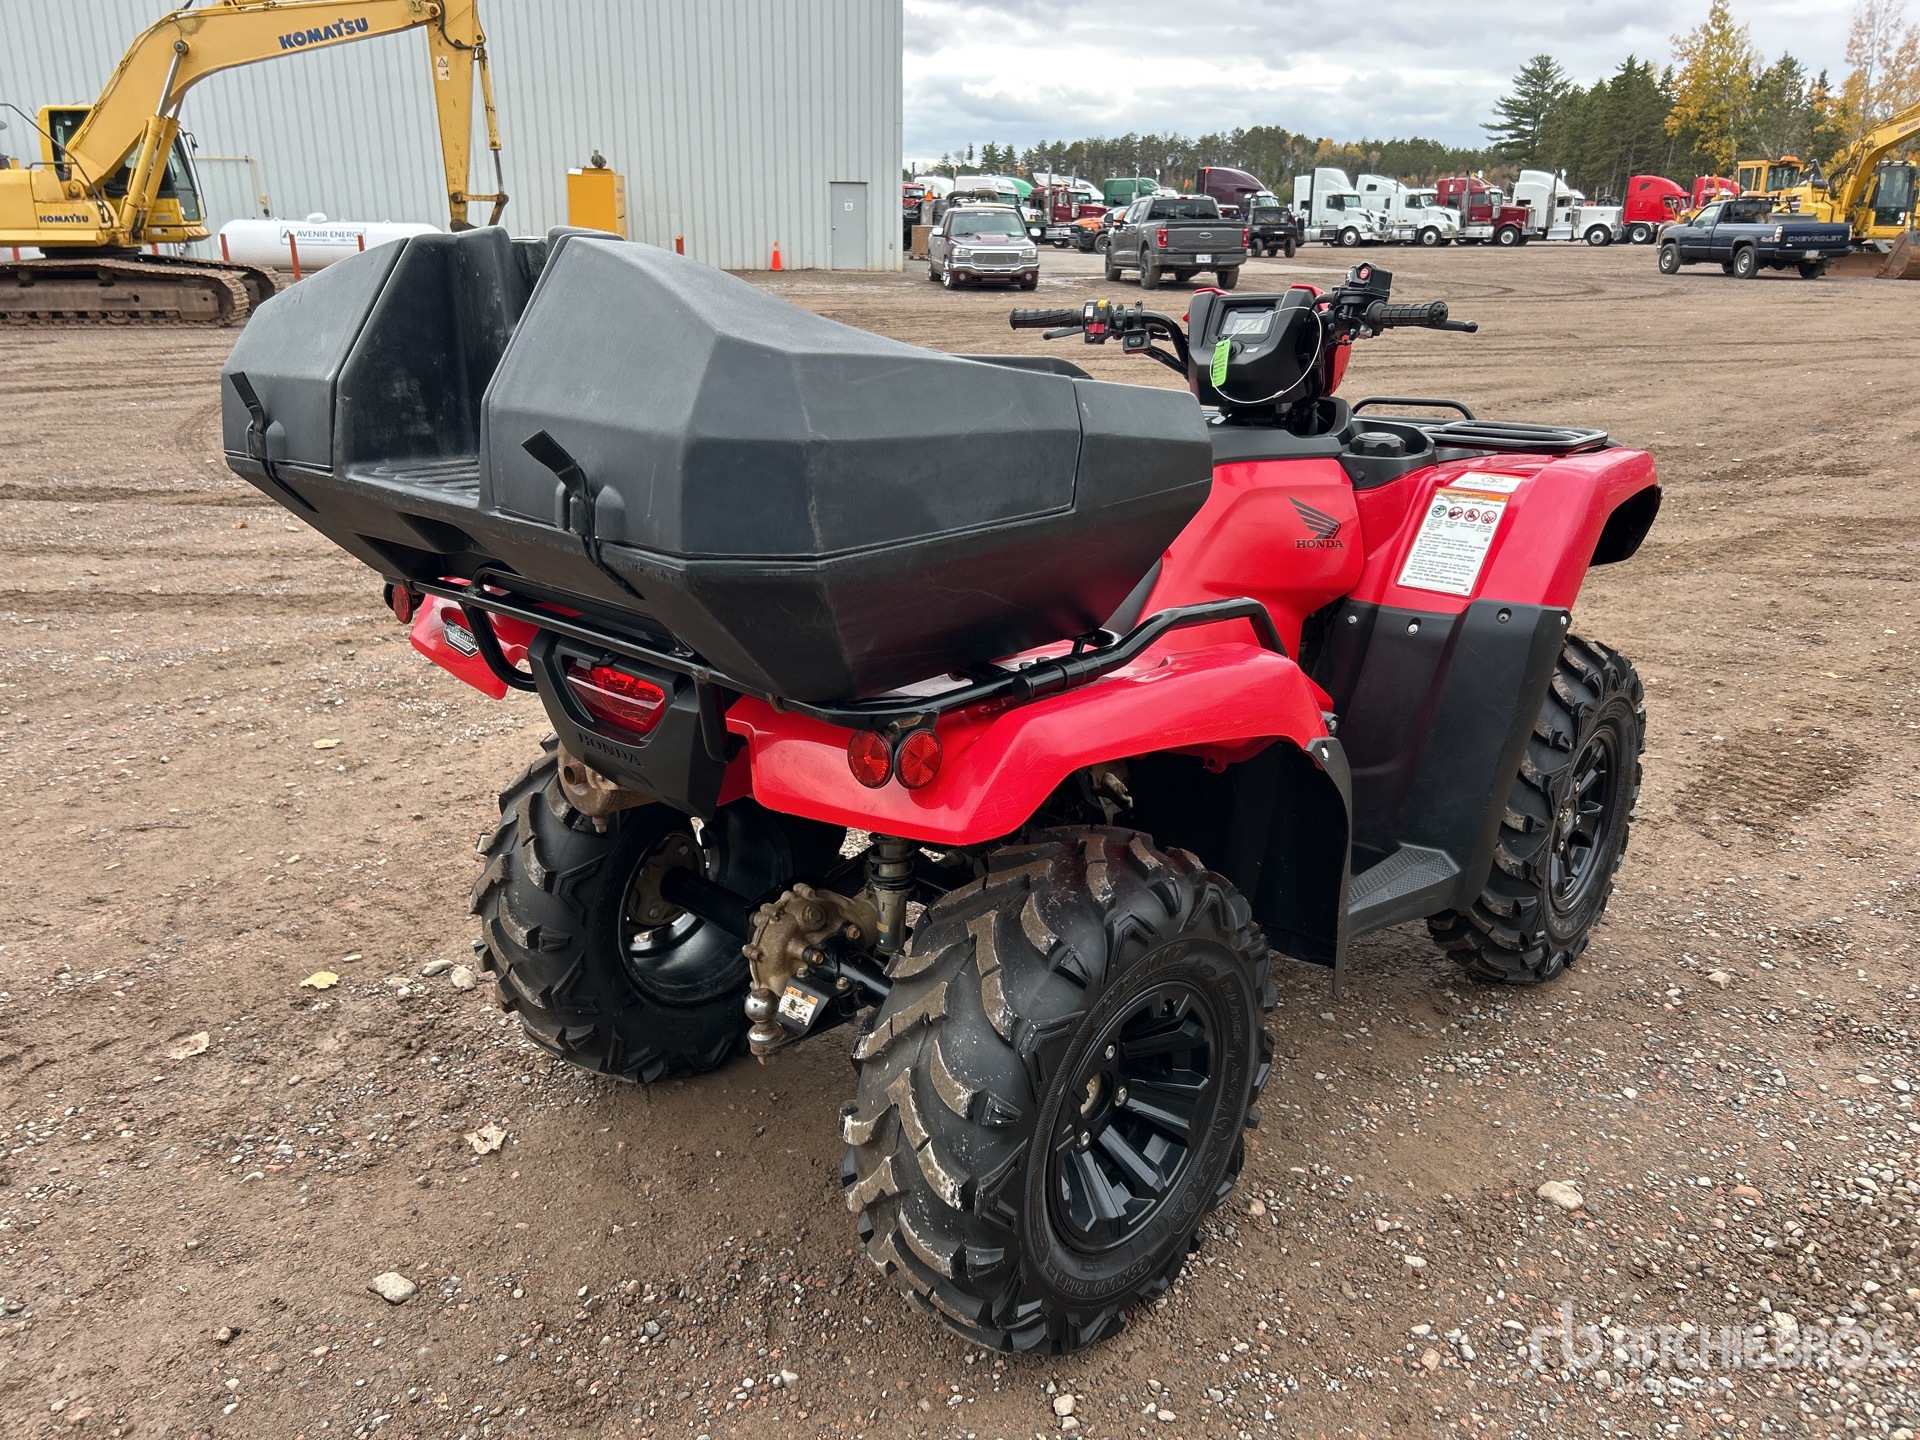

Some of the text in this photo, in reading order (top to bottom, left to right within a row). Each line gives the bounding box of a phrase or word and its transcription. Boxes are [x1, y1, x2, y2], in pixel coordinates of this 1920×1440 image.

[278, 17, 369, 50] KOMATSU
[39, 213, 89, 223] KOMATSU
[297, 230, 365, 239] AVENIR ENERGY
[1295, 539, 1344, 549] HONDA
[577, 731, 643, 767] HONDA
